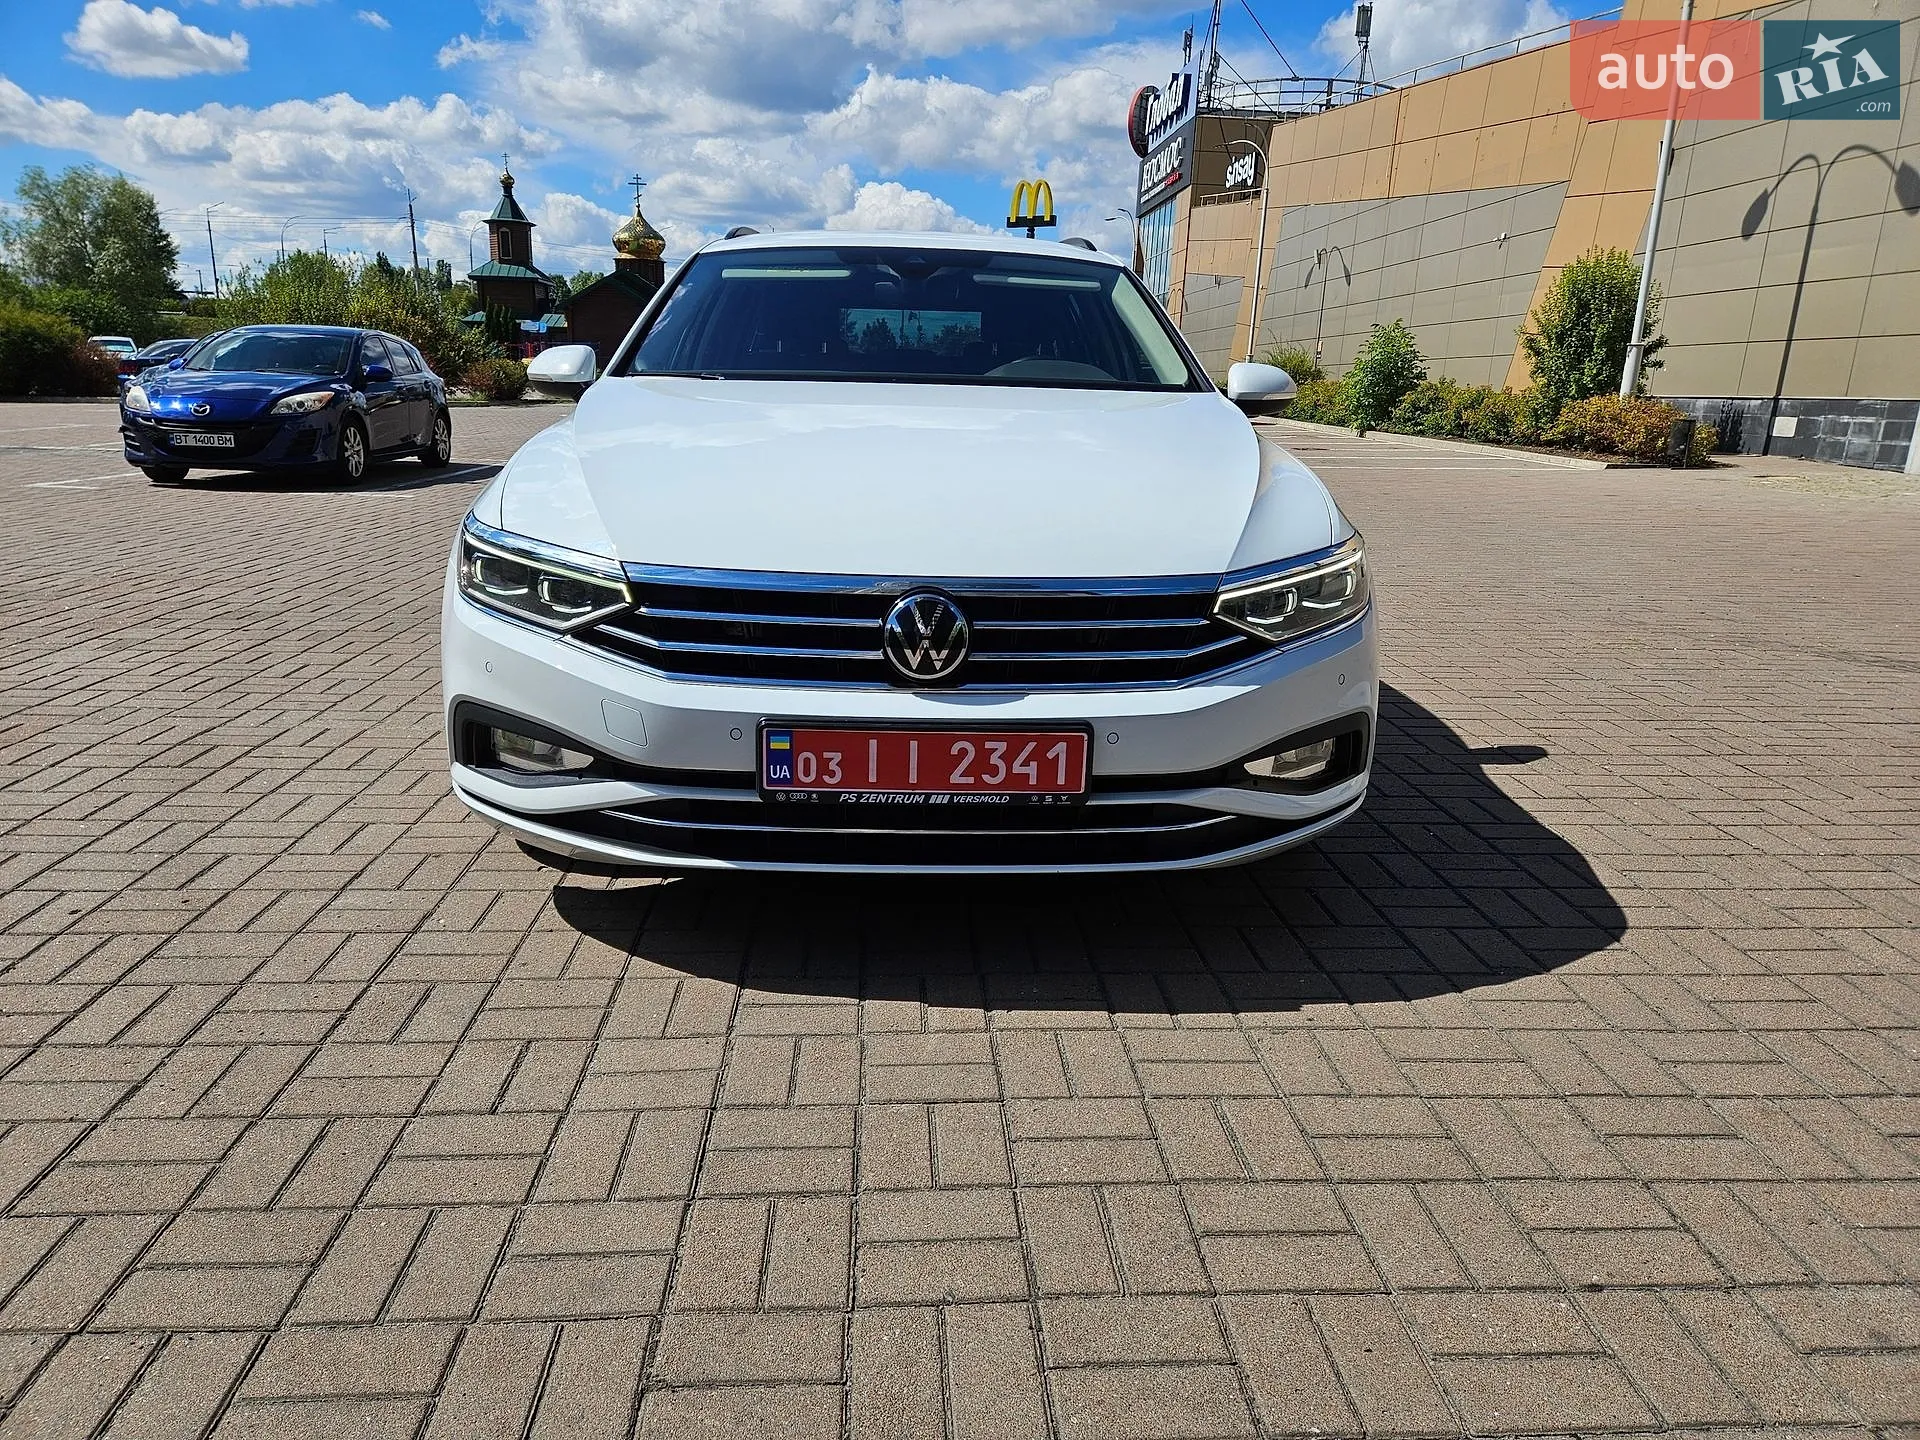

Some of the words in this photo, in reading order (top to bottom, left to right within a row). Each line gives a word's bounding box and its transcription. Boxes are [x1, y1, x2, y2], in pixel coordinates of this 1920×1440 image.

[1226, 152, 1256, 188] sinsay
[175, 434, 190, 444] BT
[192, 435, 215, 445] 1400
[218, 435, 233, 446] BM
[797, 751, 842, 784] 03
[949, 740, 1069, 785] 2341
[770, 765, 790, 779] UA
[839, 793, 858, 803] PS
[860, 793, 926, 804] ZENTRUM
[953, 796, 1010, 804] VERSMOLD
